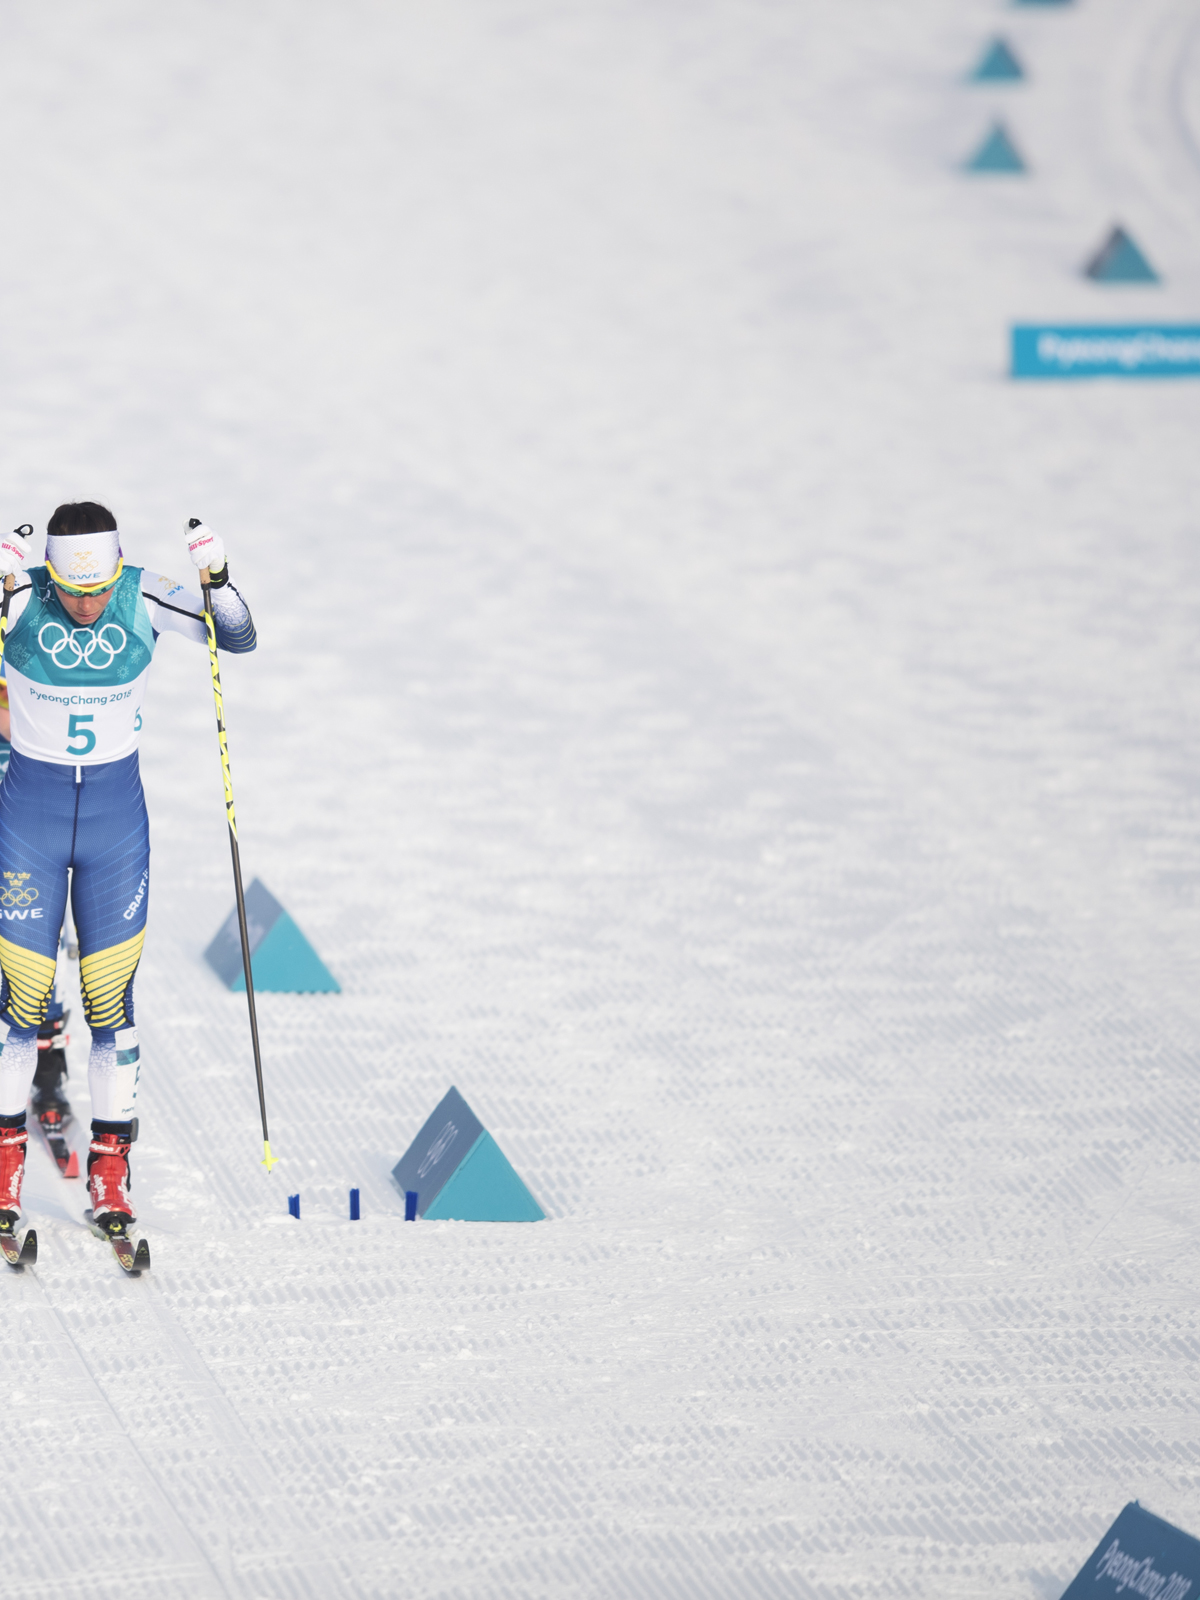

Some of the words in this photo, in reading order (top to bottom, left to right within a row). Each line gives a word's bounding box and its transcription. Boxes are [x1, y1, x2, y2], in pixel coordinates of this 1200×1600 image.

[68, 572, 101, 580] SWE
[30, 687, 107, 706] PyeongChang
[109, 688, 132, 703] 2018
[65, 713, 97, 756] 5
[123, 878, 147, 921] CRAFT
[1095, 1537, 1167, 1600] PyeongChang
